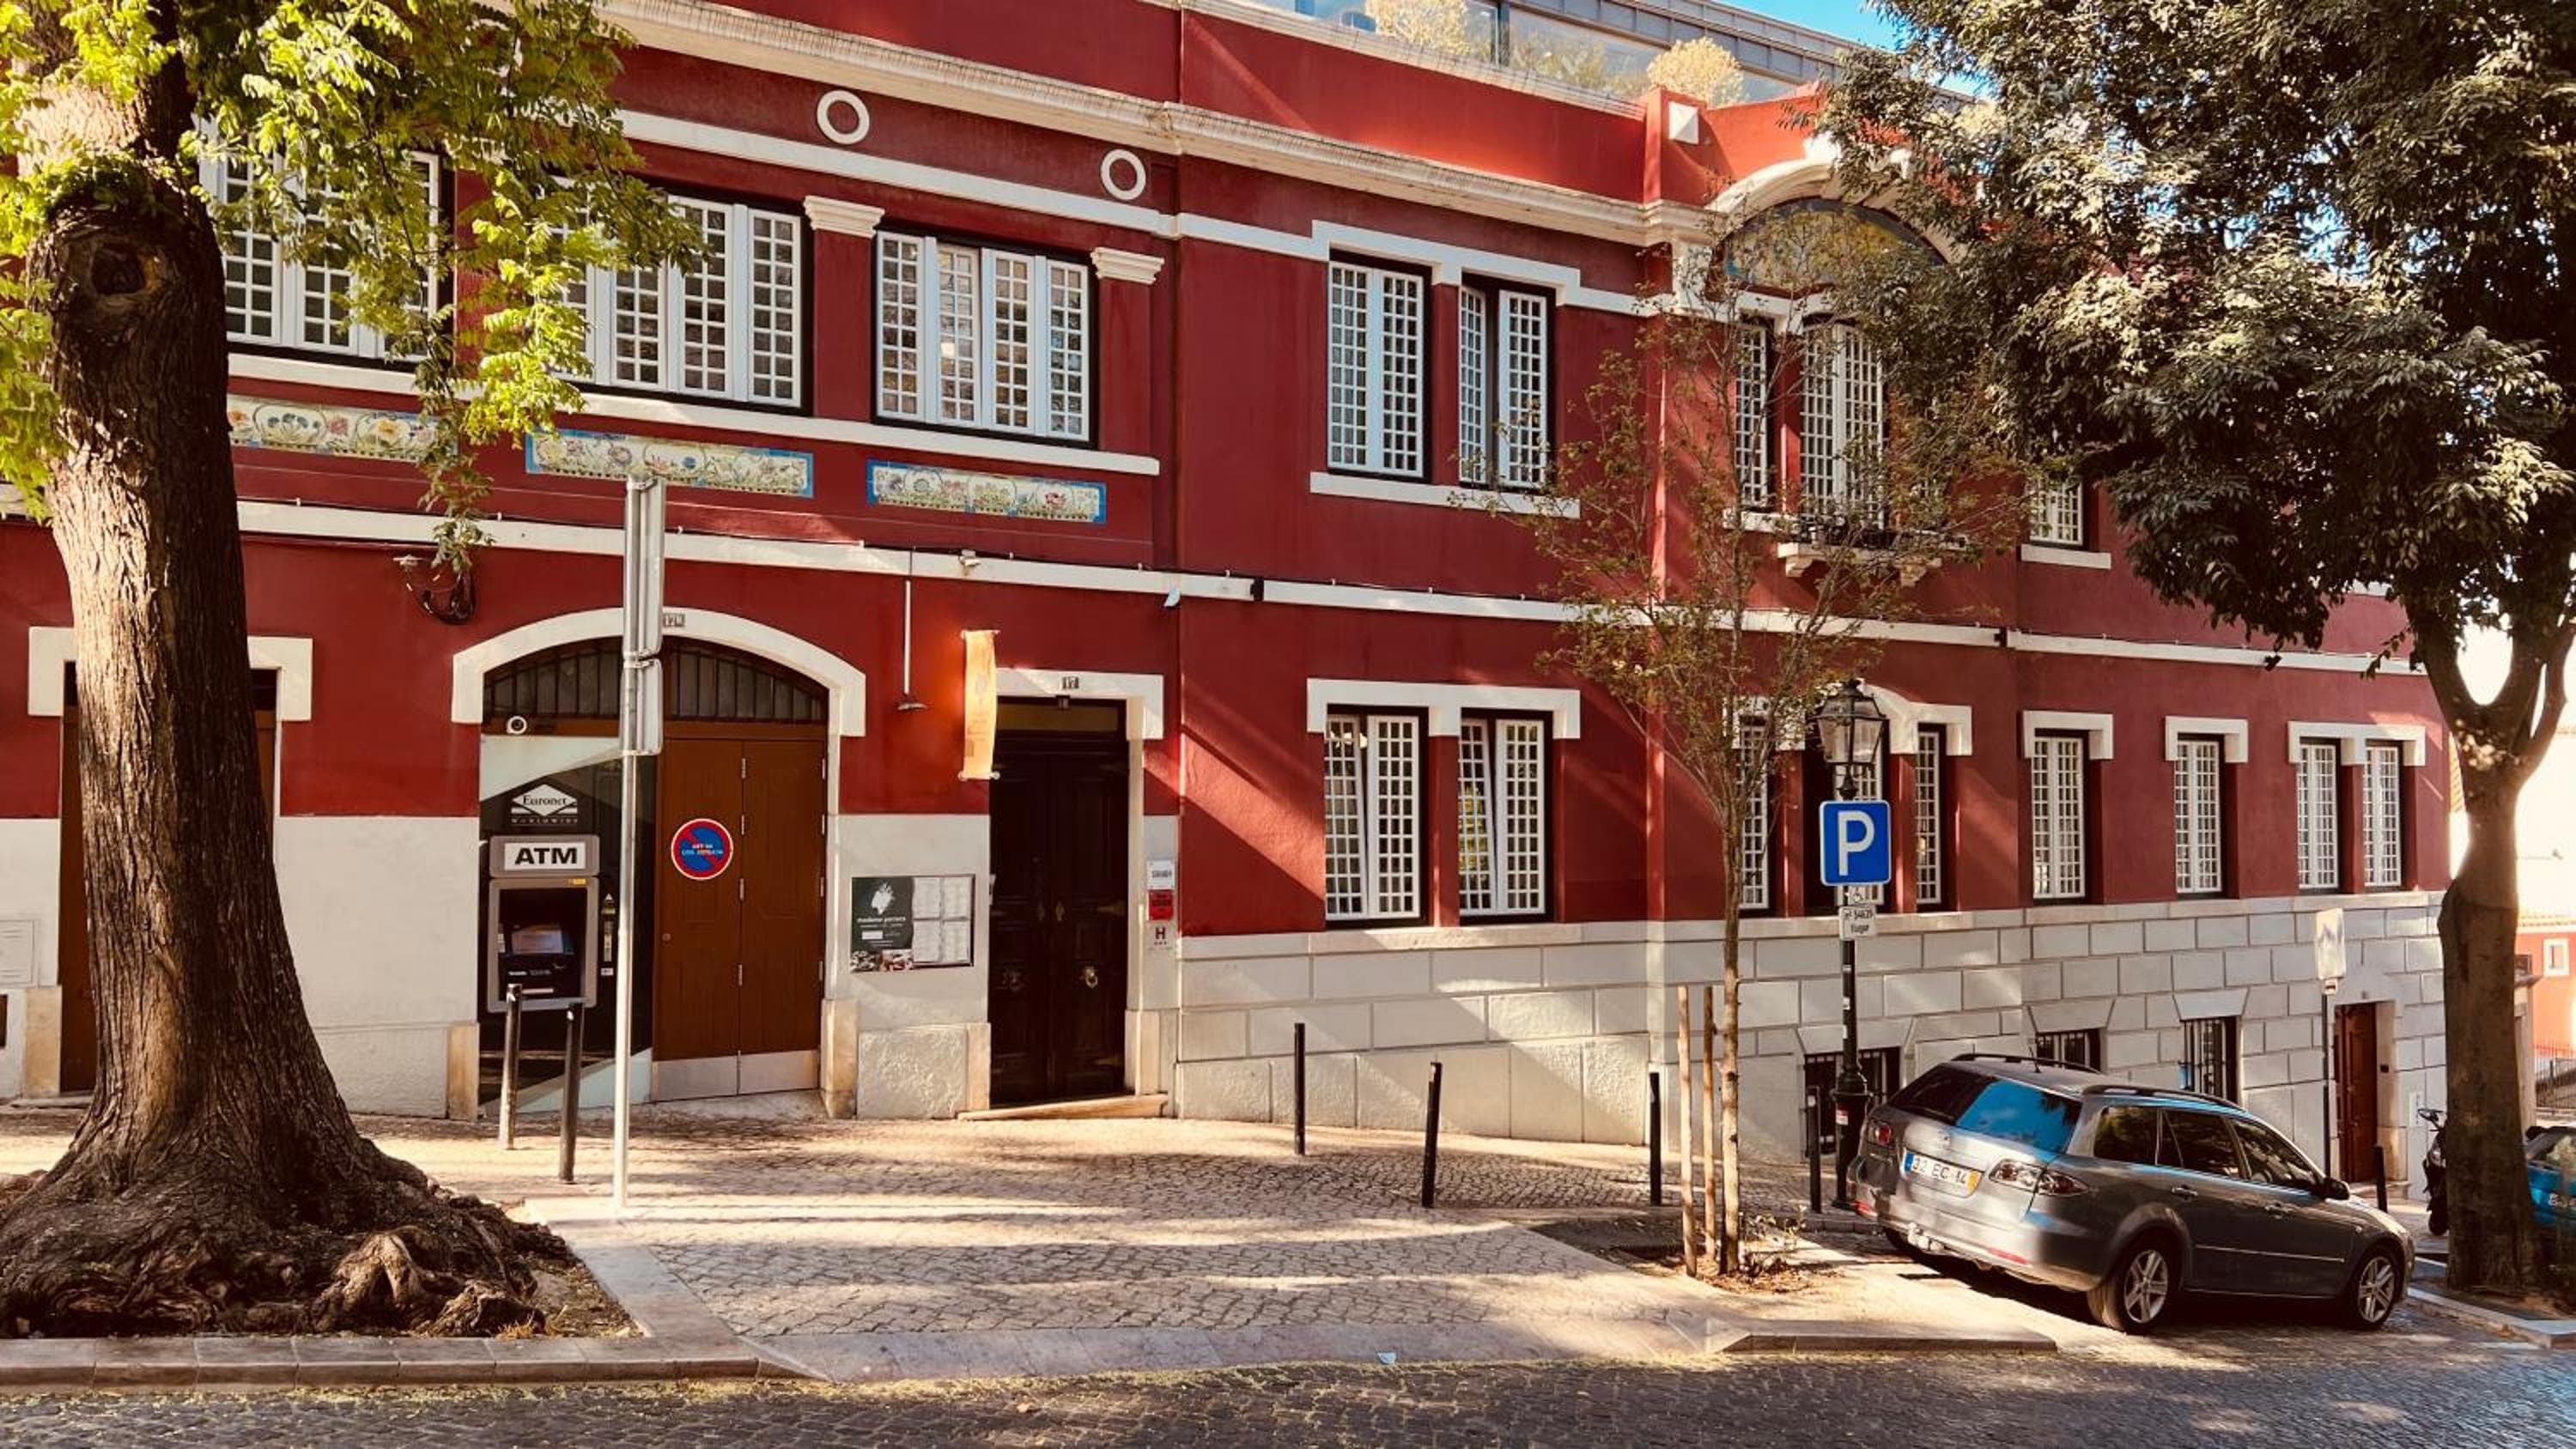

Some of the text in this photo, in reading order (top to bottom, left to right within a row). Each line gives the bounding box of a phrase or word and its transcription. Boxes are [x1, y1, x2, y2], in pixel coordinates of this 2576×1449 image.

[522, 795, 567, 806] Euronet
[1838, 810, 1875, 876] P
[514, 847, 578, 865] ATM
[1155, 927, 1166, 940] H
